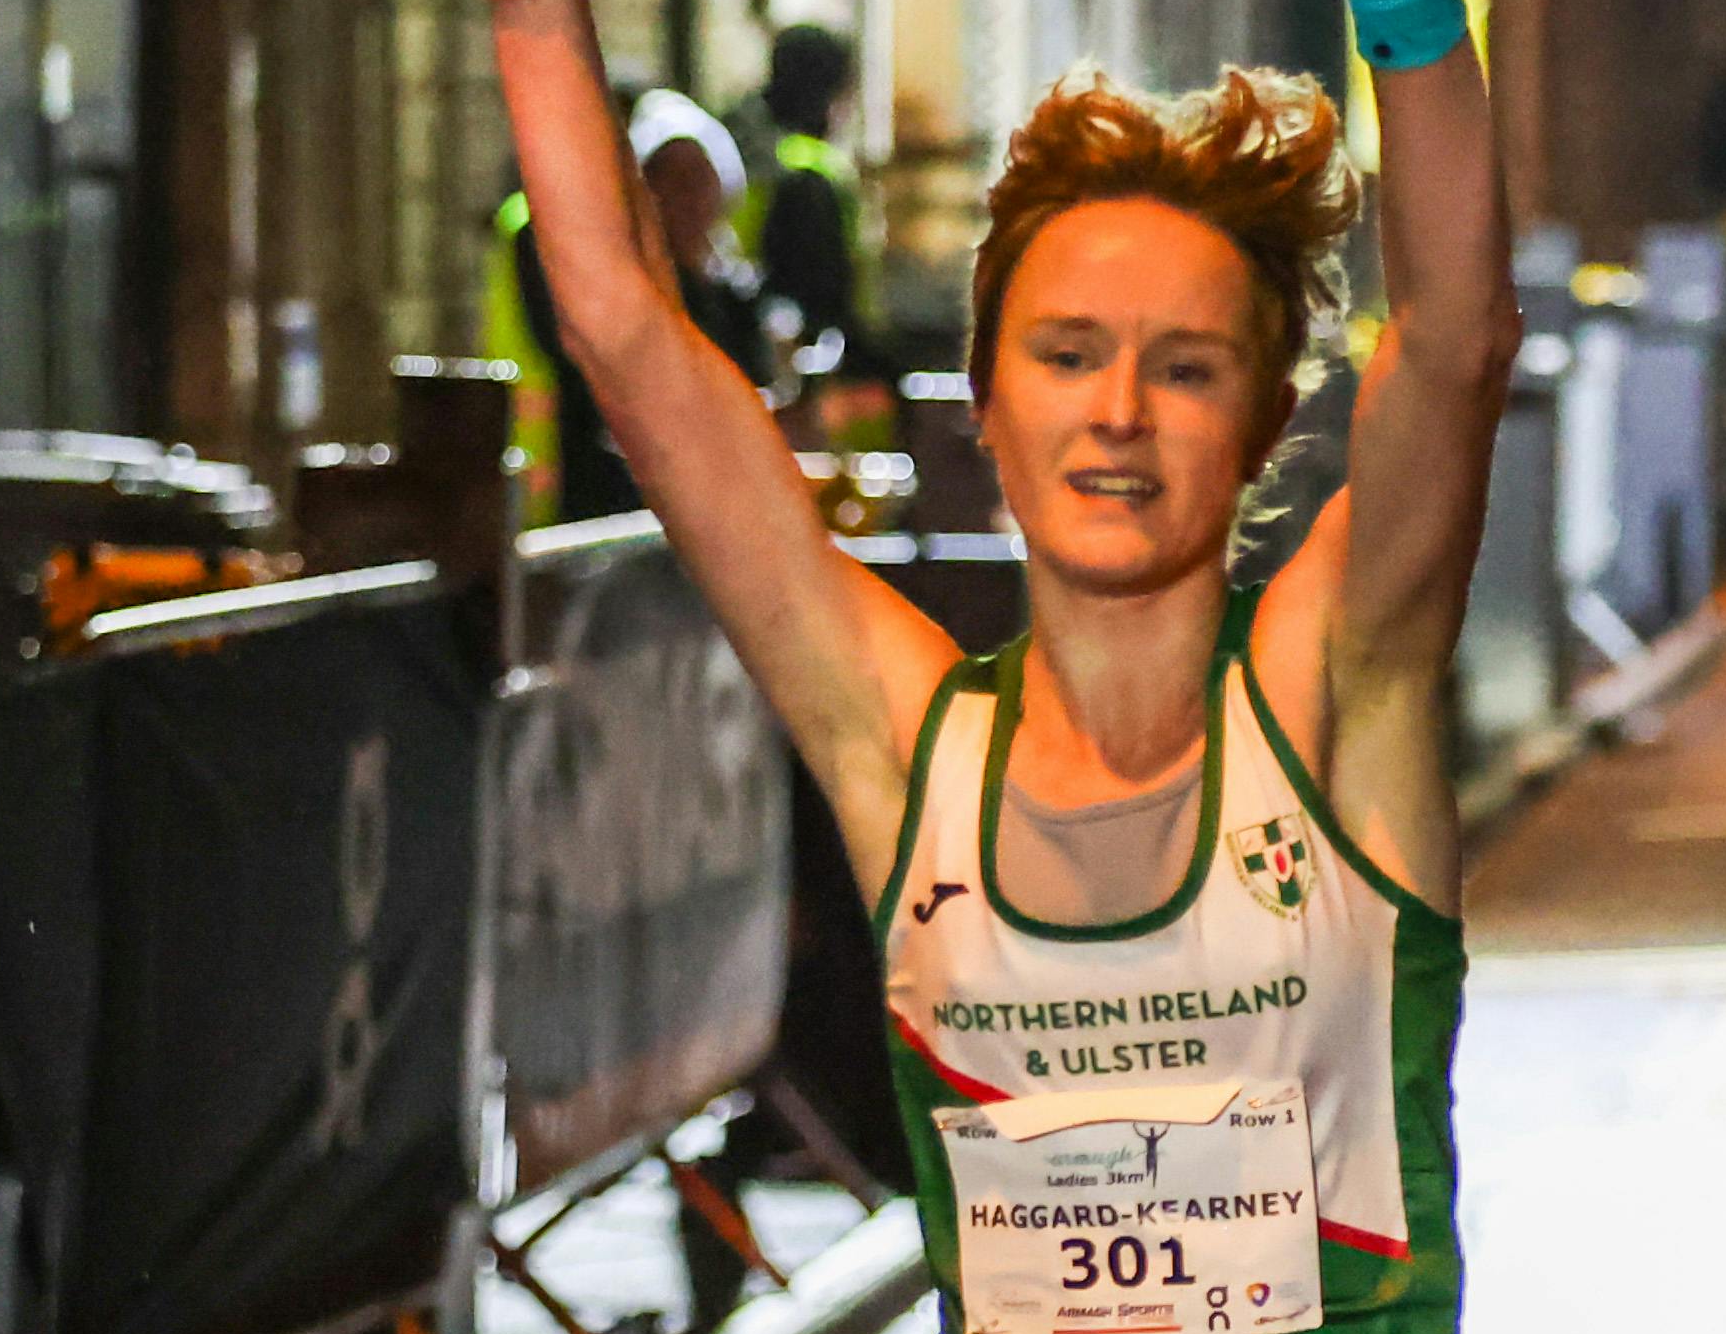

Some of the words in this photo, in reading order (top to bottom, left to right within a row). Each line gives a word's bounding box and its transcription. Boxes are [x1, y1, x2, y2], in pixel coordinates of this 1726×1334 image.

[933, 997, 1129, 1034] NORTHERN
[1139, 975, 1308, 1024] IRELAND
[1025, 1050, 1051, 1077] &
[1060, 1038, 1207, 1075] ULSTER
[1229, 1113, 1276, 1128] Row
[1285, 1108, 1296, 1124] 1
[1105, 1172, 1144, 1186] 3km
[970, 1190, 1303, 1230] HAGGARD-KEARNEY
[1060, 1236, 1197, 1291] 301
